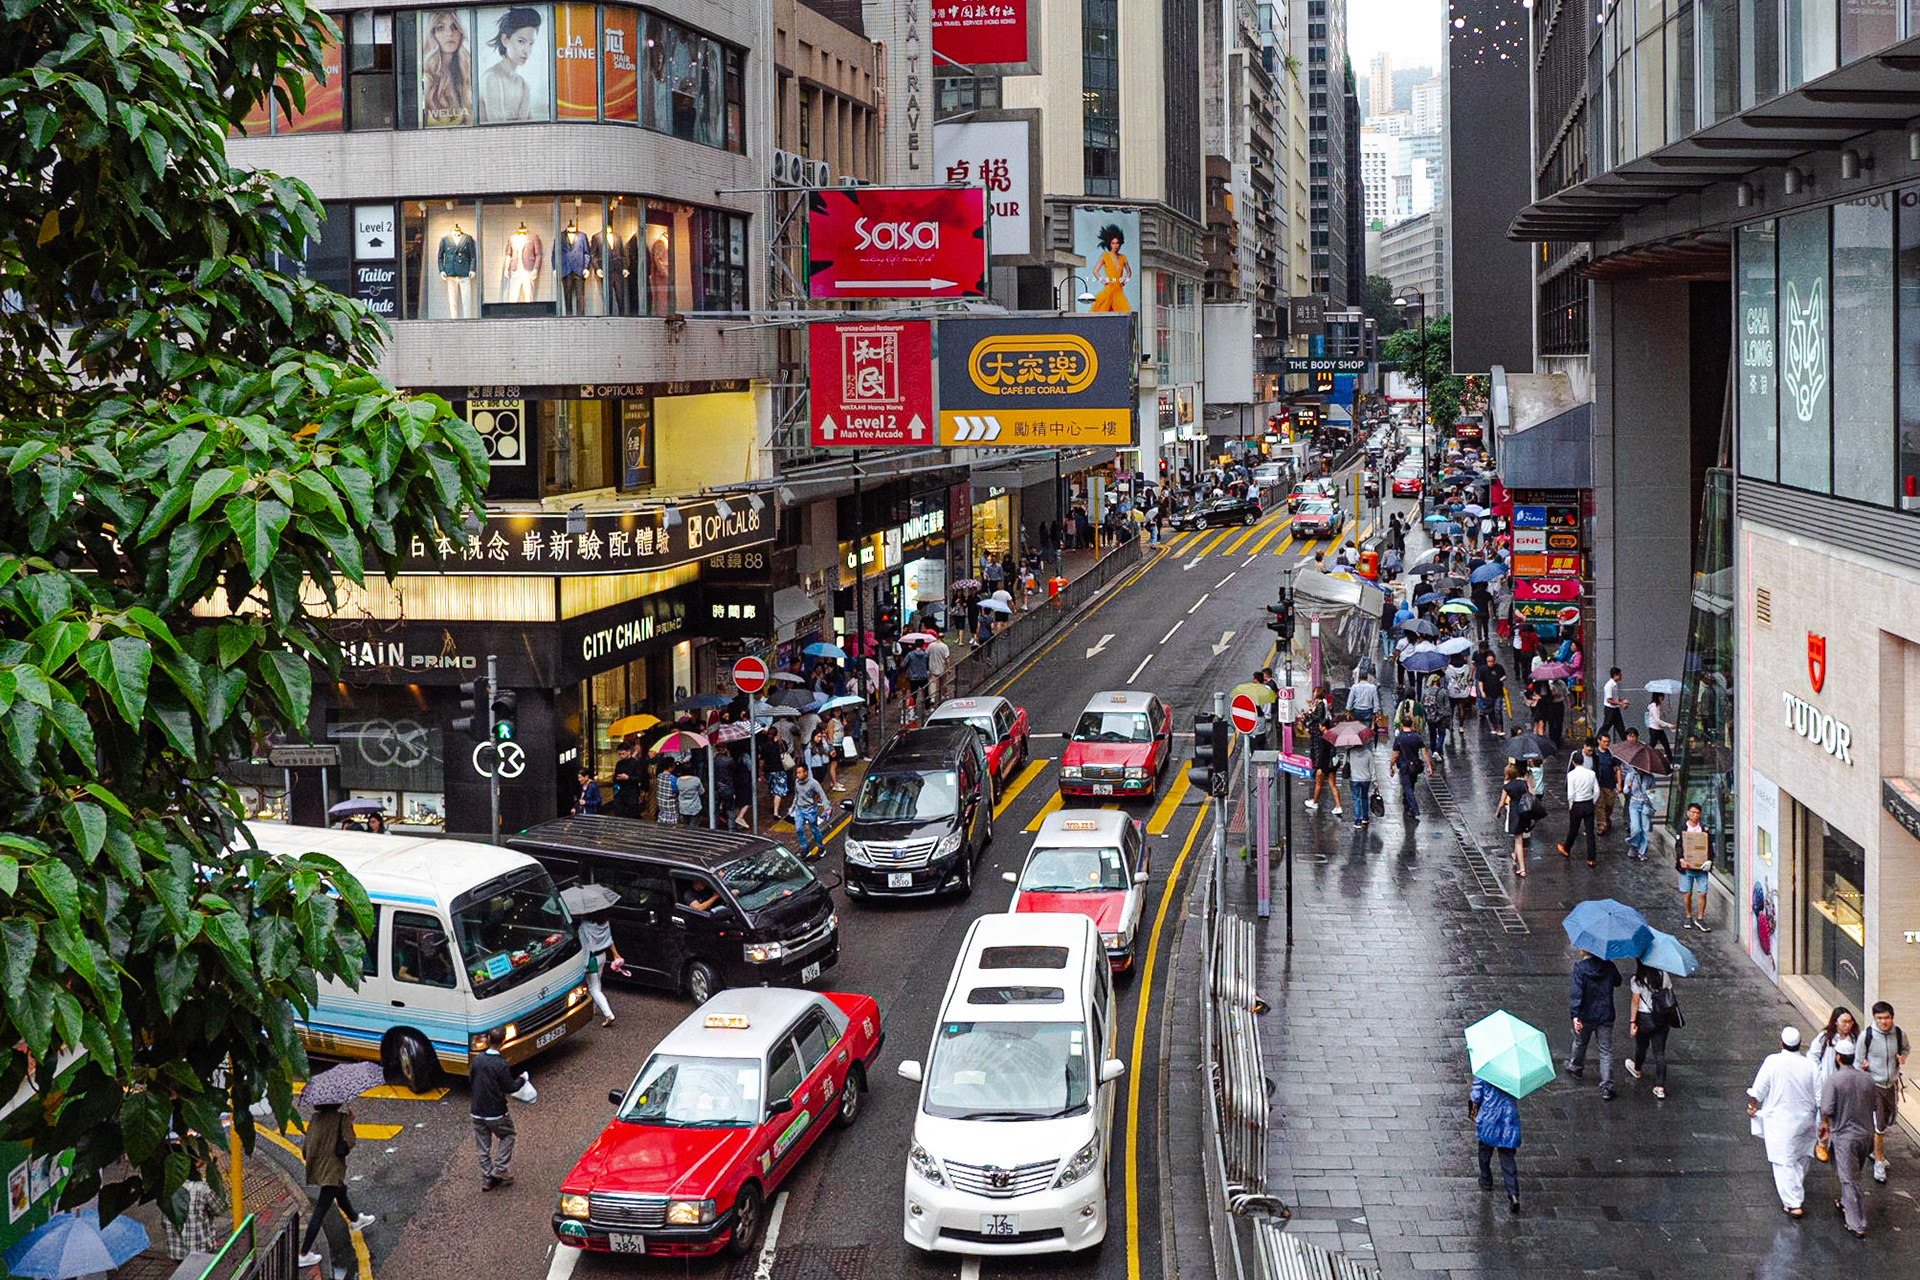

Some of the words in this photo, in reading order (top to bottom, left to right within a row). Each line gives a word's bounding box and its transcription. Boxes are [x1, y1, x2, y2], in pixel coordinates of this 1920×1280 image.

[568, 35, 583, 47] LA
[557, 47, 595, 60] CHINE
[613, 54, 630, 63] HAIR
[613, 62, 636, 71] SALON
[428, 108, 470, 118] WELLA
[360, 221, 384, 233] Level
[387, 222, 393, 232] 2
[855, 217, 939, 250] Sasa
[358, 268, 395, 282] Tailor
[1744, 340, 1773, 367] LONG
[1289, 361, 1308, 369] THE
[1311, 361, 1336, 369] BODY
[1338, 361, 1364, 369] SHOP
[1001, 386, 1024, 395] CAFÉ
[1037, 386, 1066, 394] CORAL
[846, 414, 885, 428] Level
[887, 415, 896, 428] 2
[840, 430, 858, 438] Man
[860, 430, 873, 438] Yee
[875, 430, 903, 438] Arcade
[583, 629, 613, 661] CITY
[615, 616, 655, 650] CHAIN
[655, 617, 682, 637] PRIMO
[411, 655, 476, 669] PRIMO
[1783, 691, 1851, 765] TUDOR
